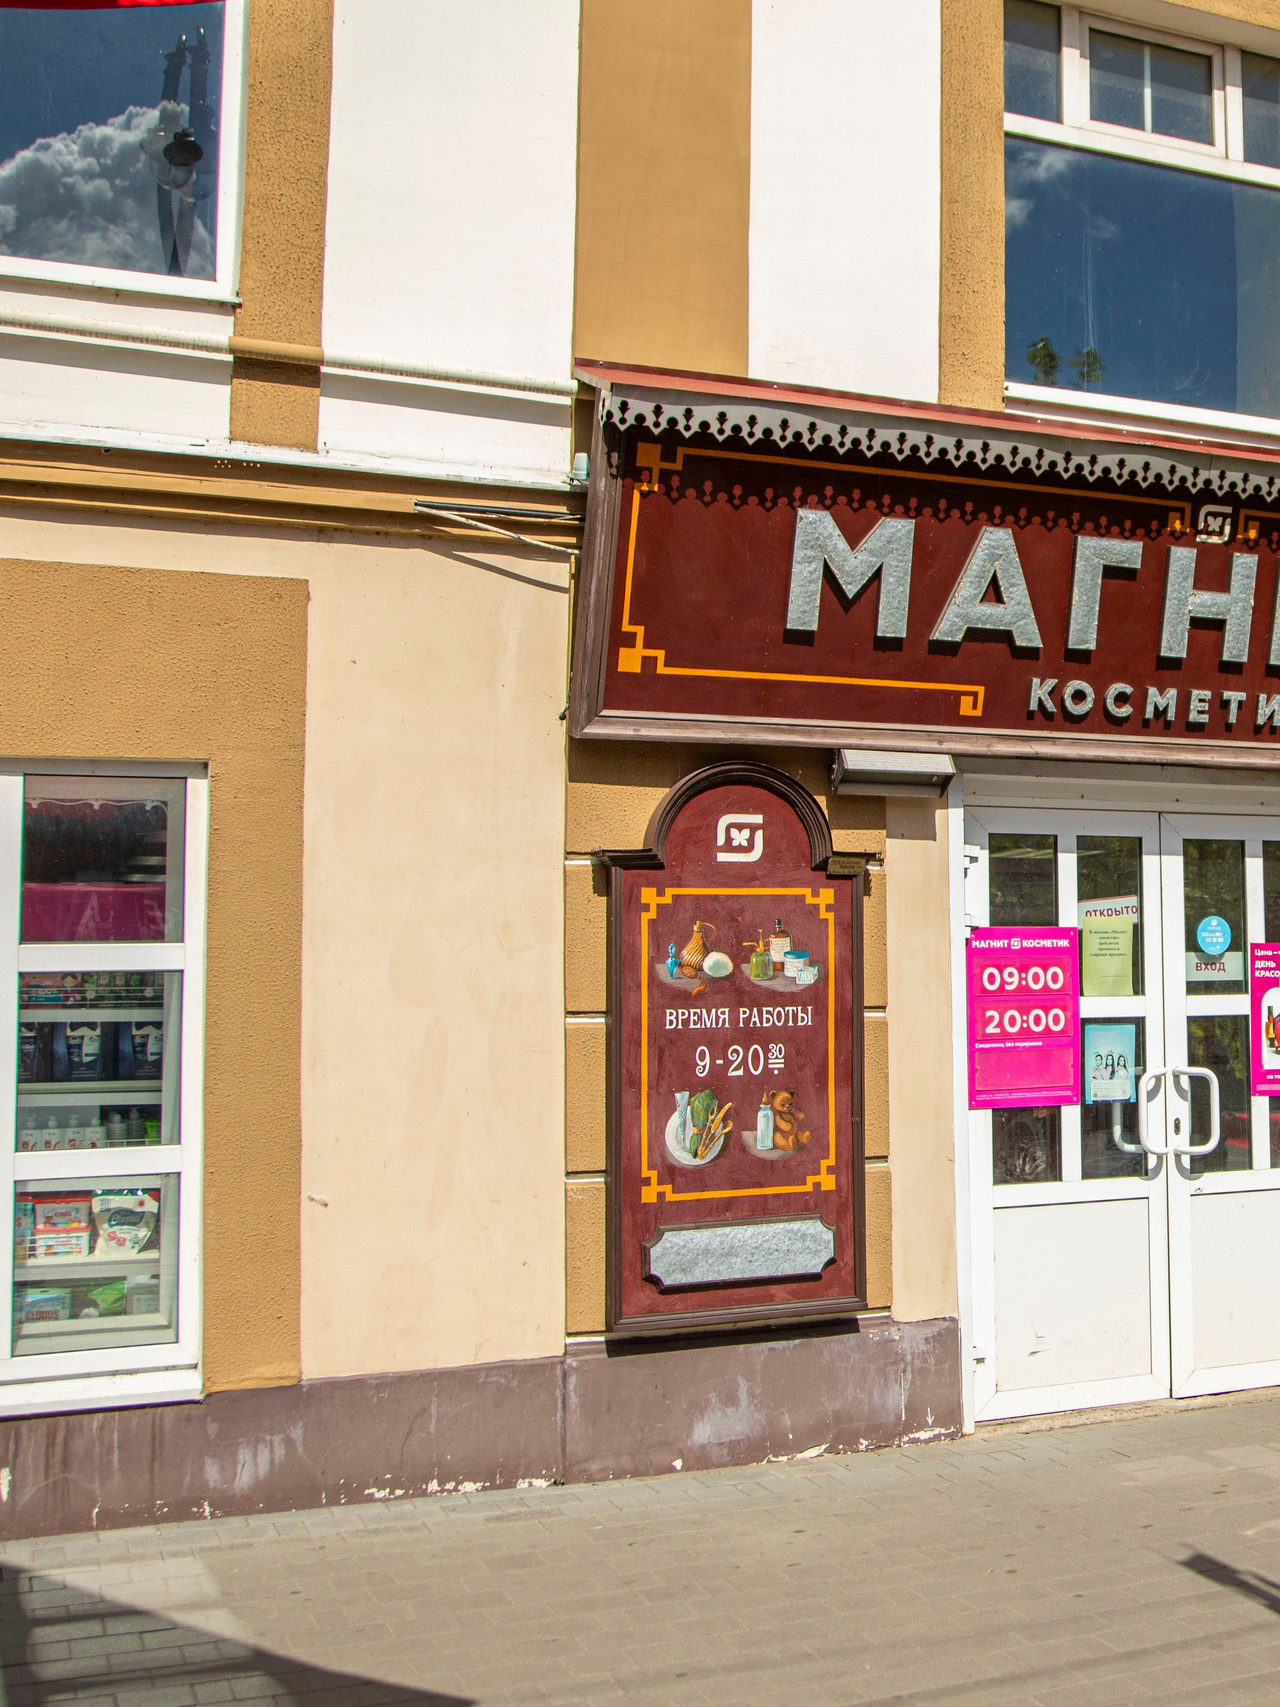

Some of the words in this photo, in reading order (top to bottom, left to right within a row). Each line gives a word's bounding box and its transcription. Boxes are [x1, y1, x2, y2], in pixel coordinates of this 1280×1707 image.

[1085, 905, 1139, 918] ОТКРЫТО
[972, 940, 1009, 948] МАГНИТ
[1022, 939, 1070, 947] КОСМЕТИК
[1195, 962, 1226, 973] ВХОД
[1254, 960, 1276, 968] ДЕНЬ
[982, 966, 1064, 991] 09:00
[665, 1008, 730, 1029] ВРЕМЯ
[738, 1006, 813, 1028] РАБОТЫ
[985, 1008, 1065, 1034] 20:00
[25, 1309, 60, 1321] CLOUDS
